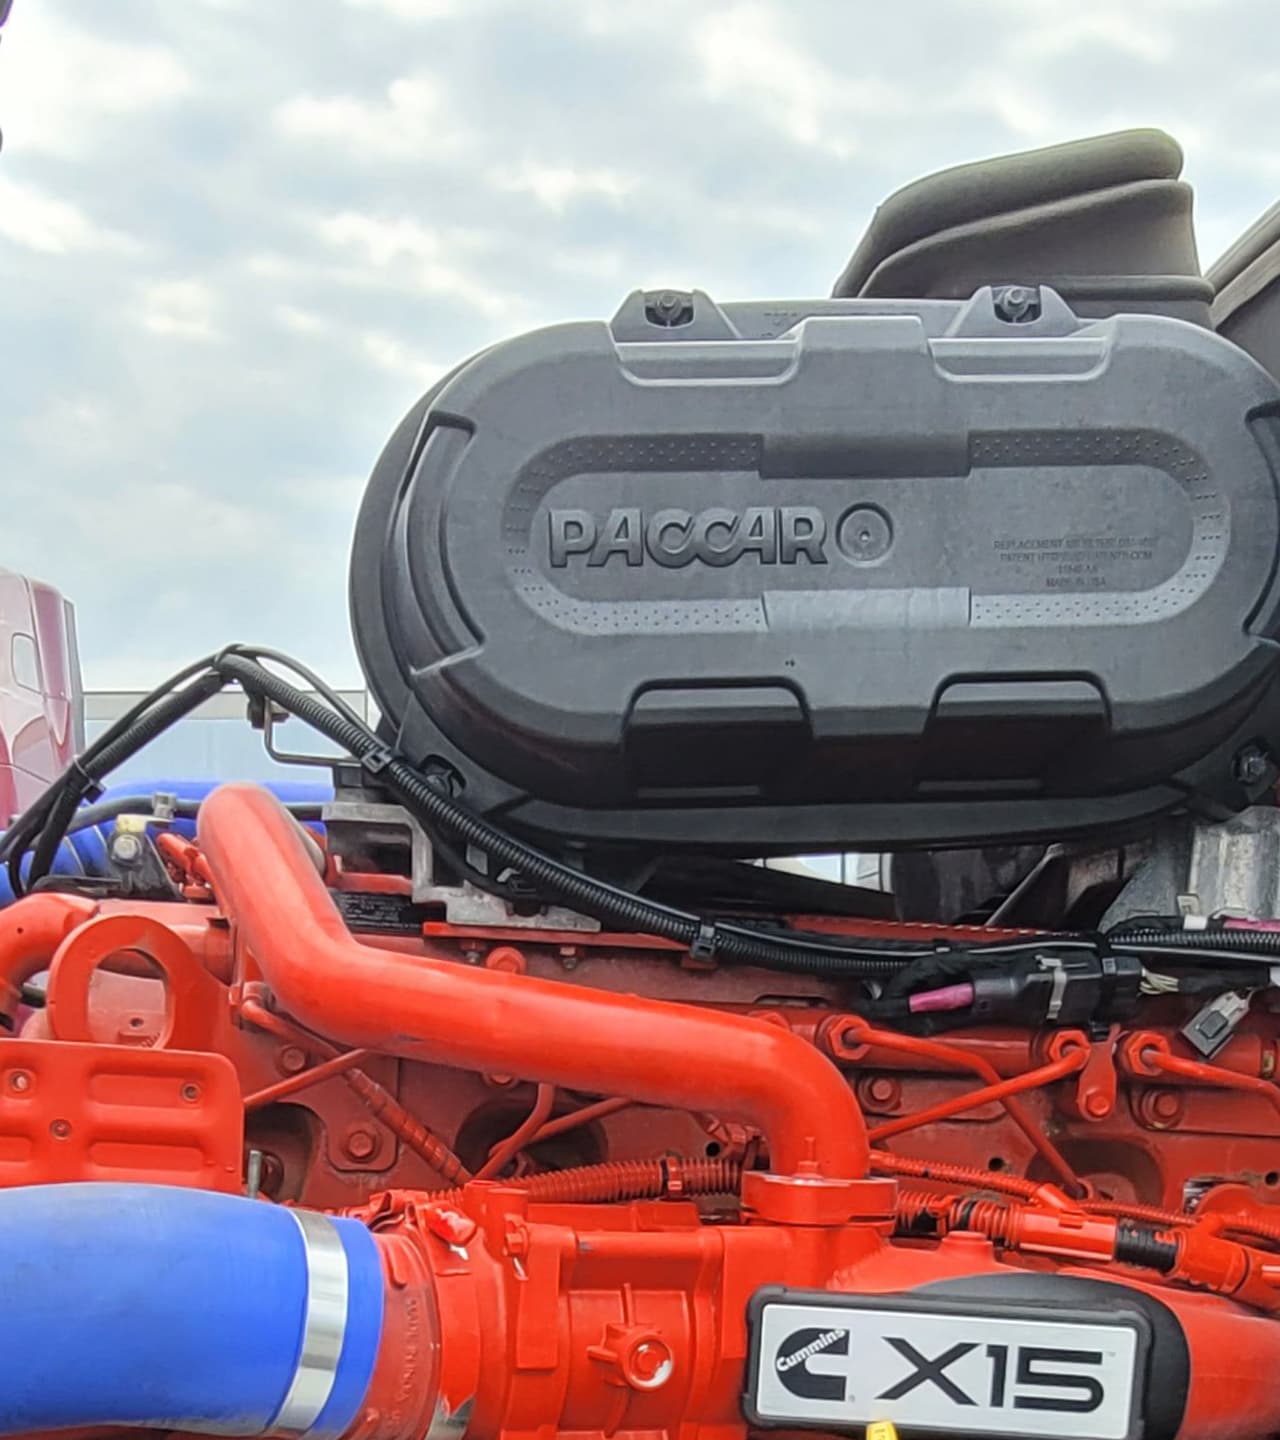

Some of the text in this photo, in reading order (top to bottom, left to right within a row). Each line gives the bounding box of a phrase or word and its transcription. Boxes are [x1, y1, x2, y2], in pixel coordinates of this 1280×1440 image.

[548, 506, 829, 569] PACCAR
[776, 1328, 1105, 1414] Cummins X15
